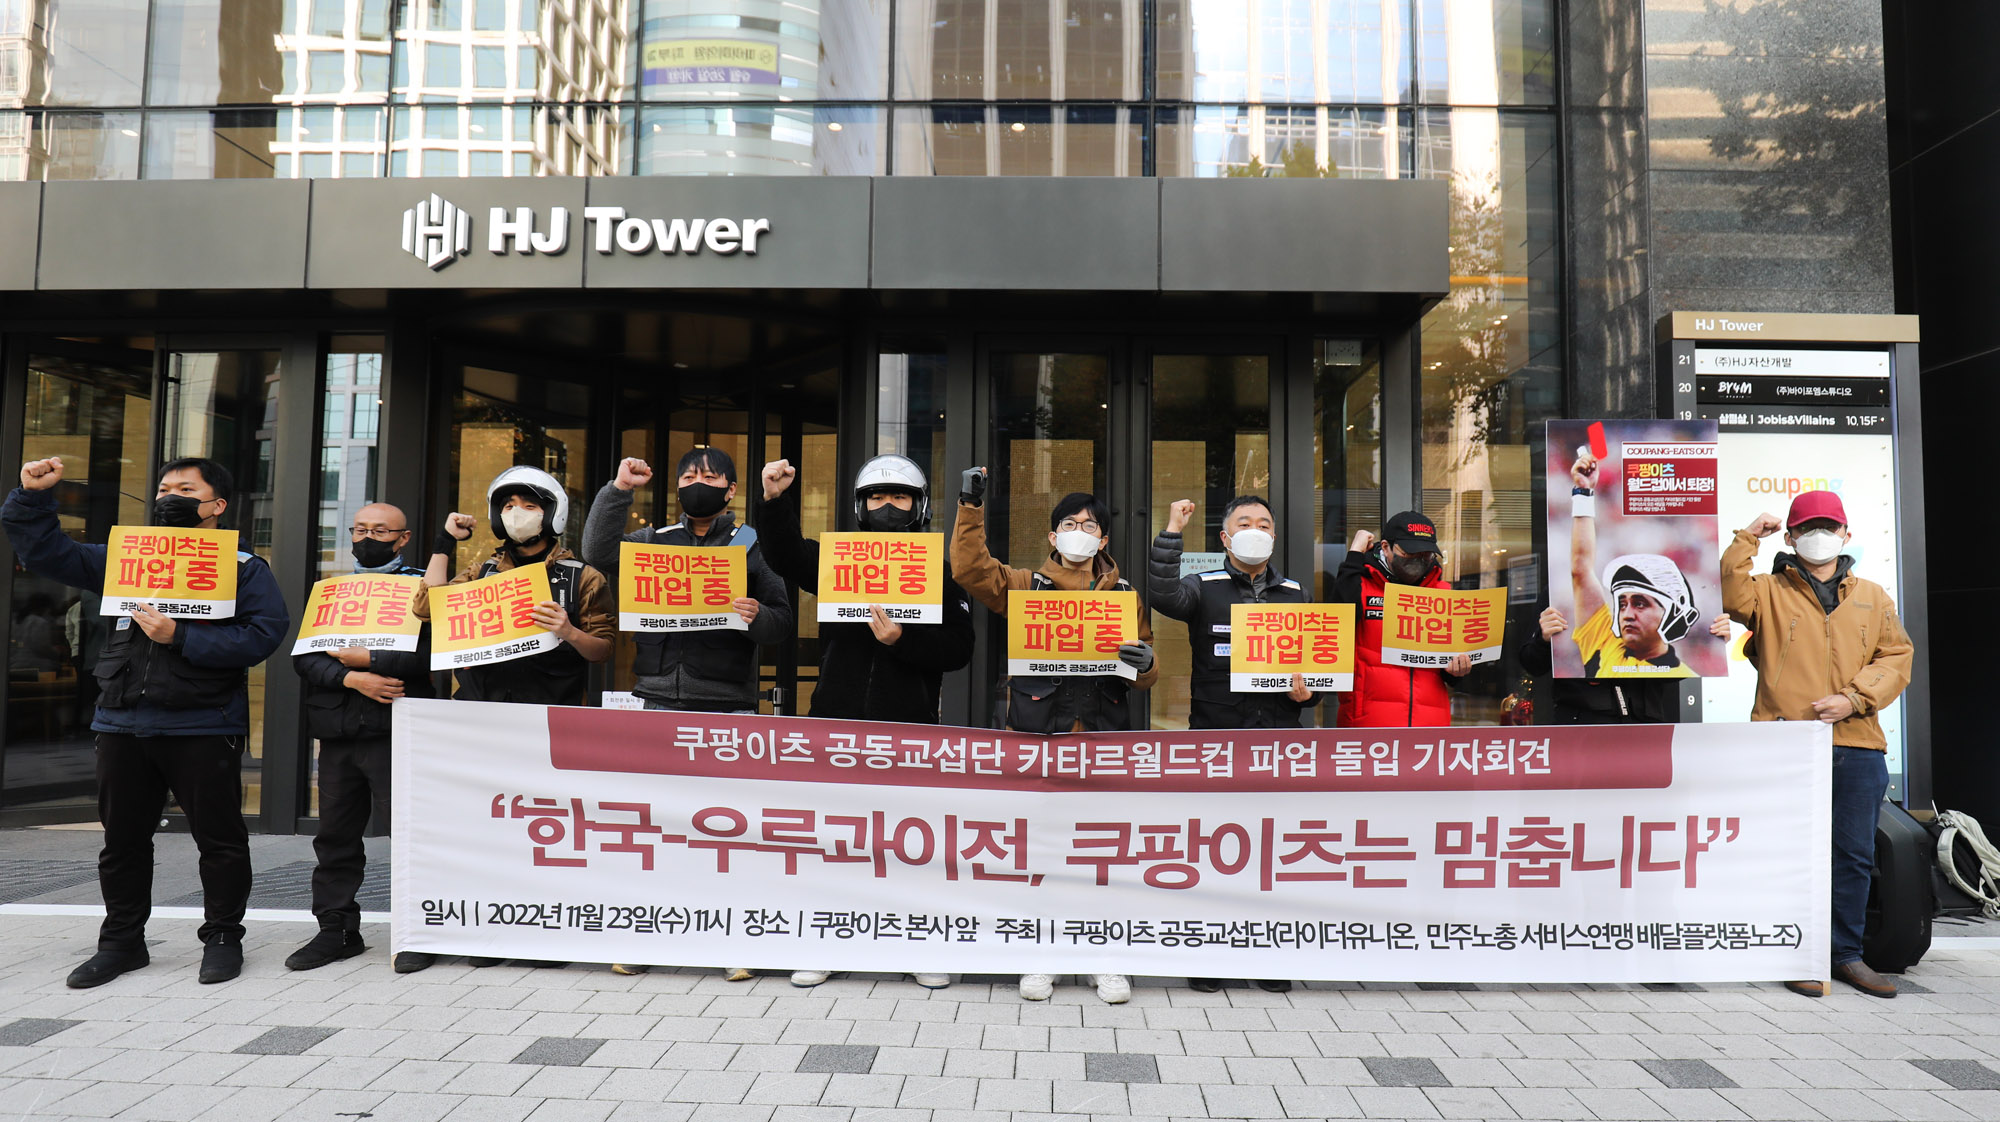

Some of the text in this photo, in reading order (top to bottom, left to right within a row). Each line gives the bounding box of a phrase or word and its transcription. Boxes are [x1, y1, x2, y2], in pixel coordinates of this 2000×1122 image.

[489, 206, 769, 255] HJ Tower
[1696, 319, 1764, 332] HJ Tower
[1679, 355, 1690, 364] 21
[1679, 383, 1691, 392] 20
[1679, 410, 1692, 421] 19
[1758, 414, 1836, 426] Jobis&Villains
[1628, 464, 1675, 477] 쿠팡이츠
[1628, 477, 1714, 492] 월드컵에서 퇴장!
[120, 536, 219, 560] 쿠팡이츠는
[834, 541, 927, 562] 쿠팡이츠는
[118, 558, 218, 591] 파업 중
[634, 553, 730, 577] 쿠팡이츠는
[833, 564, 927, 595] 파업 중
[321, 582, 410, 602] 쿠팡이츠는
[447, 577, 532, 611] 쿠팡이츠는
[634, 576, 731, 606] 파업 중
[158, 603, 212, 614] 공동교섭단
[313, 600, 406, 627] 파업 중
[883, 609, 921, 619] 동교섭단
[1024, 600, 1122, 621] 쿠팡이츠는
[1397, 594, 1491, 618] 쿠팡이츠는
[448, 608, 504, 640] 파업
[510, 596, 536, 628] 중
[640, 617, 728, 628] 쿠팡이츠 공동교섭단
[1247, 612, 1340, 632] 쿠팡이츠는
[1024, 623, 1123, 653] 파업 중
[1397, 615, 1490, 644] 파업 중
[311, 639, 395, 647] 쿠팡이츠 공동교섭단
[453, 639, 540, 664] 쿠팡이츠 공동교섭단
[1246, 635, 1303, 664] 파업
[1312, 635, 1339, 664] 중
[1029, 664, 1117, 672] 쿠팡이츠 공동교섭단
[1401, 654, 1436, 664] 쿠팡이츠
[1252, 678, 1287, 687] 쿠팡이츠
[1687, 695, 1696, 705] 9
[674, 727, 1550, 778] 쿠팡이츠 공동교섭단 카타르월드컵 파업 돌입 기자회견
[1067, 818, 1416, 891] 쿠팡이츠는
[1436, 816, 1739, 888] 멈춥니다”
[422, 900, 465, 926] 일시
[488, 903, 562, 929] 2022년
[567, 904, 603, 931] 11월
[607, 906, 690, 934] 23일(수)
[694, 908, 731, 935] 11시
[744, 909, 789, 936] 장소
[811, 911, 902, 939] 쿠팡이츠
[995, 919, 1040, 943] 주최
[1063, 920, 1156, 946] 쿠팡이츠
[1427, 923, 1517, 950] 민주노총
[1521, 923, 1633, 950] 서비스연맹
[1637, 923, 1802, 950] 배달플랫폼노조)
